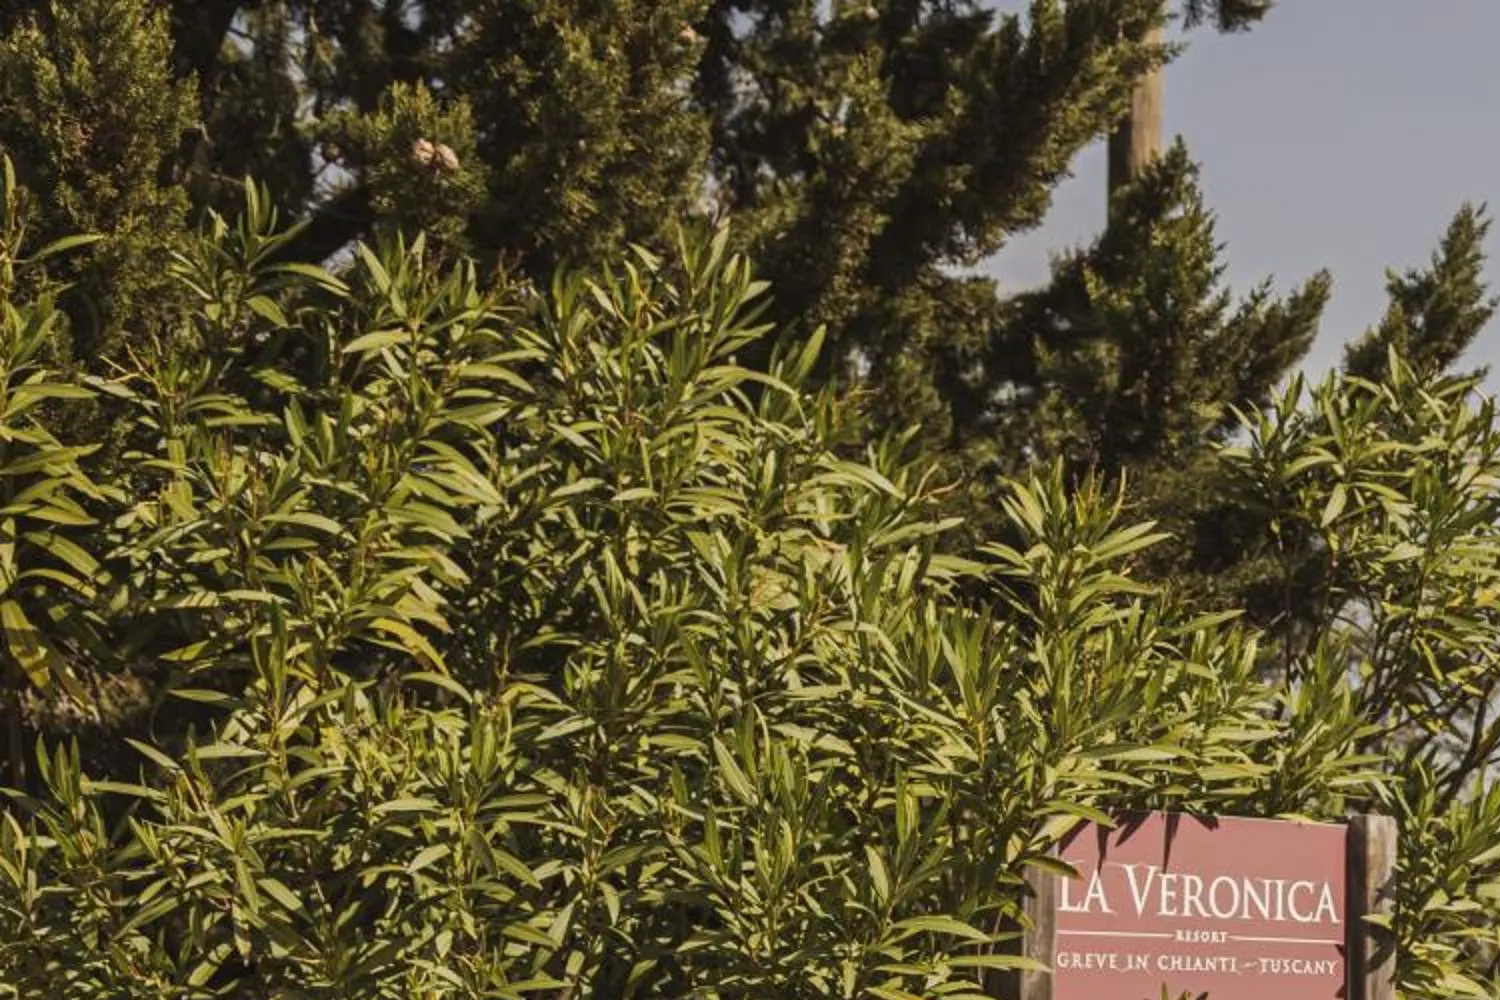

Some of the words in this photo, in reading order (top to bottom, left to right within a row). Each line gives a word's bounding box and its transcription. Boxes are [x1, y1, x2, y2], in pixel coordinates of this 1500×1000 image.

[1057, 863, 1113, 915] LA
[1122, 862, 1343, 925] VERONICA
[1175, 930, 1228, 943] RESORT
[1057, 952, 1117, 970] GREVE
[1124, 955, 1150, 973] IN
[1157, 955, 1239, 974] CHIANTI
[1257, 957, 1338, 975] TUSCANY
